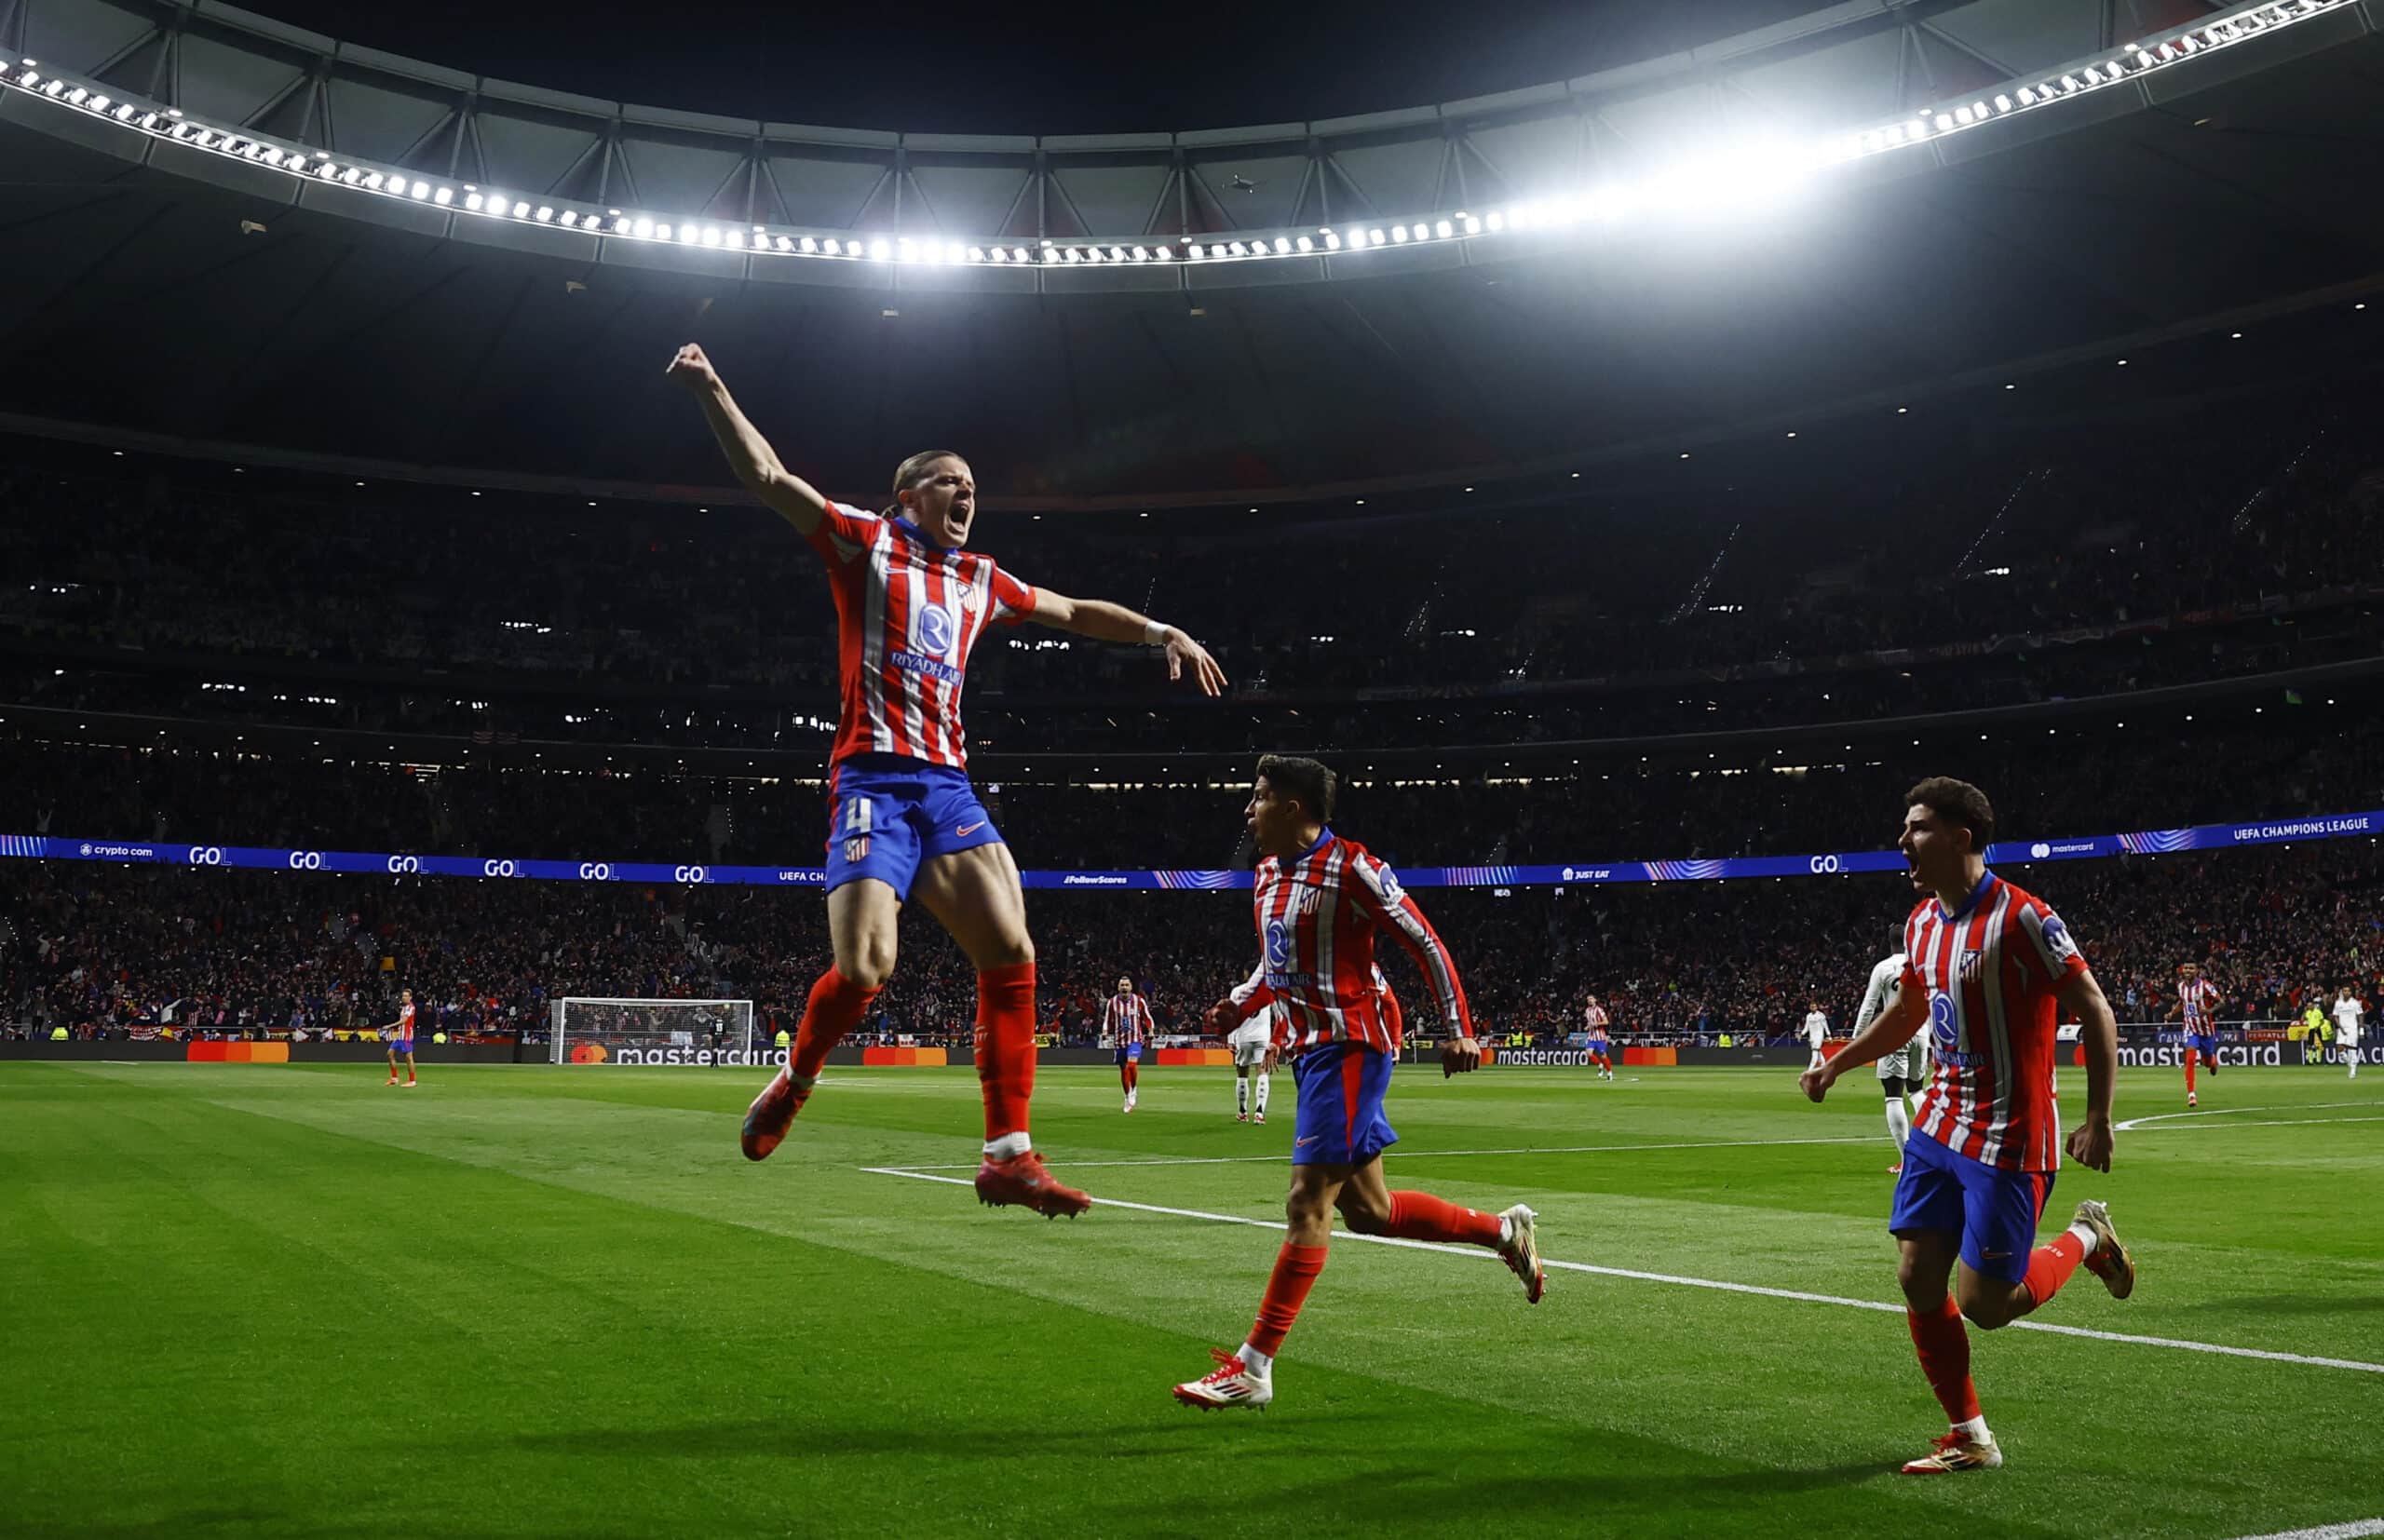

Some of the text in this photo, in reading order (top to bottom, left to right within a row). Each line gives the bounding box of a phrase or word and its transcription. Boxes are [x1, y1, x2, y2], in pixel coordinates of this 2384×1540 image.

[891, 652, 944, 678] RIYADH
[846, 798, 872, 834] 4
[2234, 817, 2369, 840] UEFA CHAMPIONS LEAGUE
[94, 845, 153, 857] cryptocom
[2052, 842, 2094, 853] mastercard
[289, 851, 332, 871] GOL
[484, 859, 525, 878] GOL
[675, 866, 714, 884] GOL
[779, 871, 807, 881] UEFA
[1575, 870, 1610, 880] JUST EAT
[616, 1045, 791, 1065] mastercard
[1497, 1047, 1589, 1066] mastercard
[2117, 1042, 2281, 1066] mastcard
